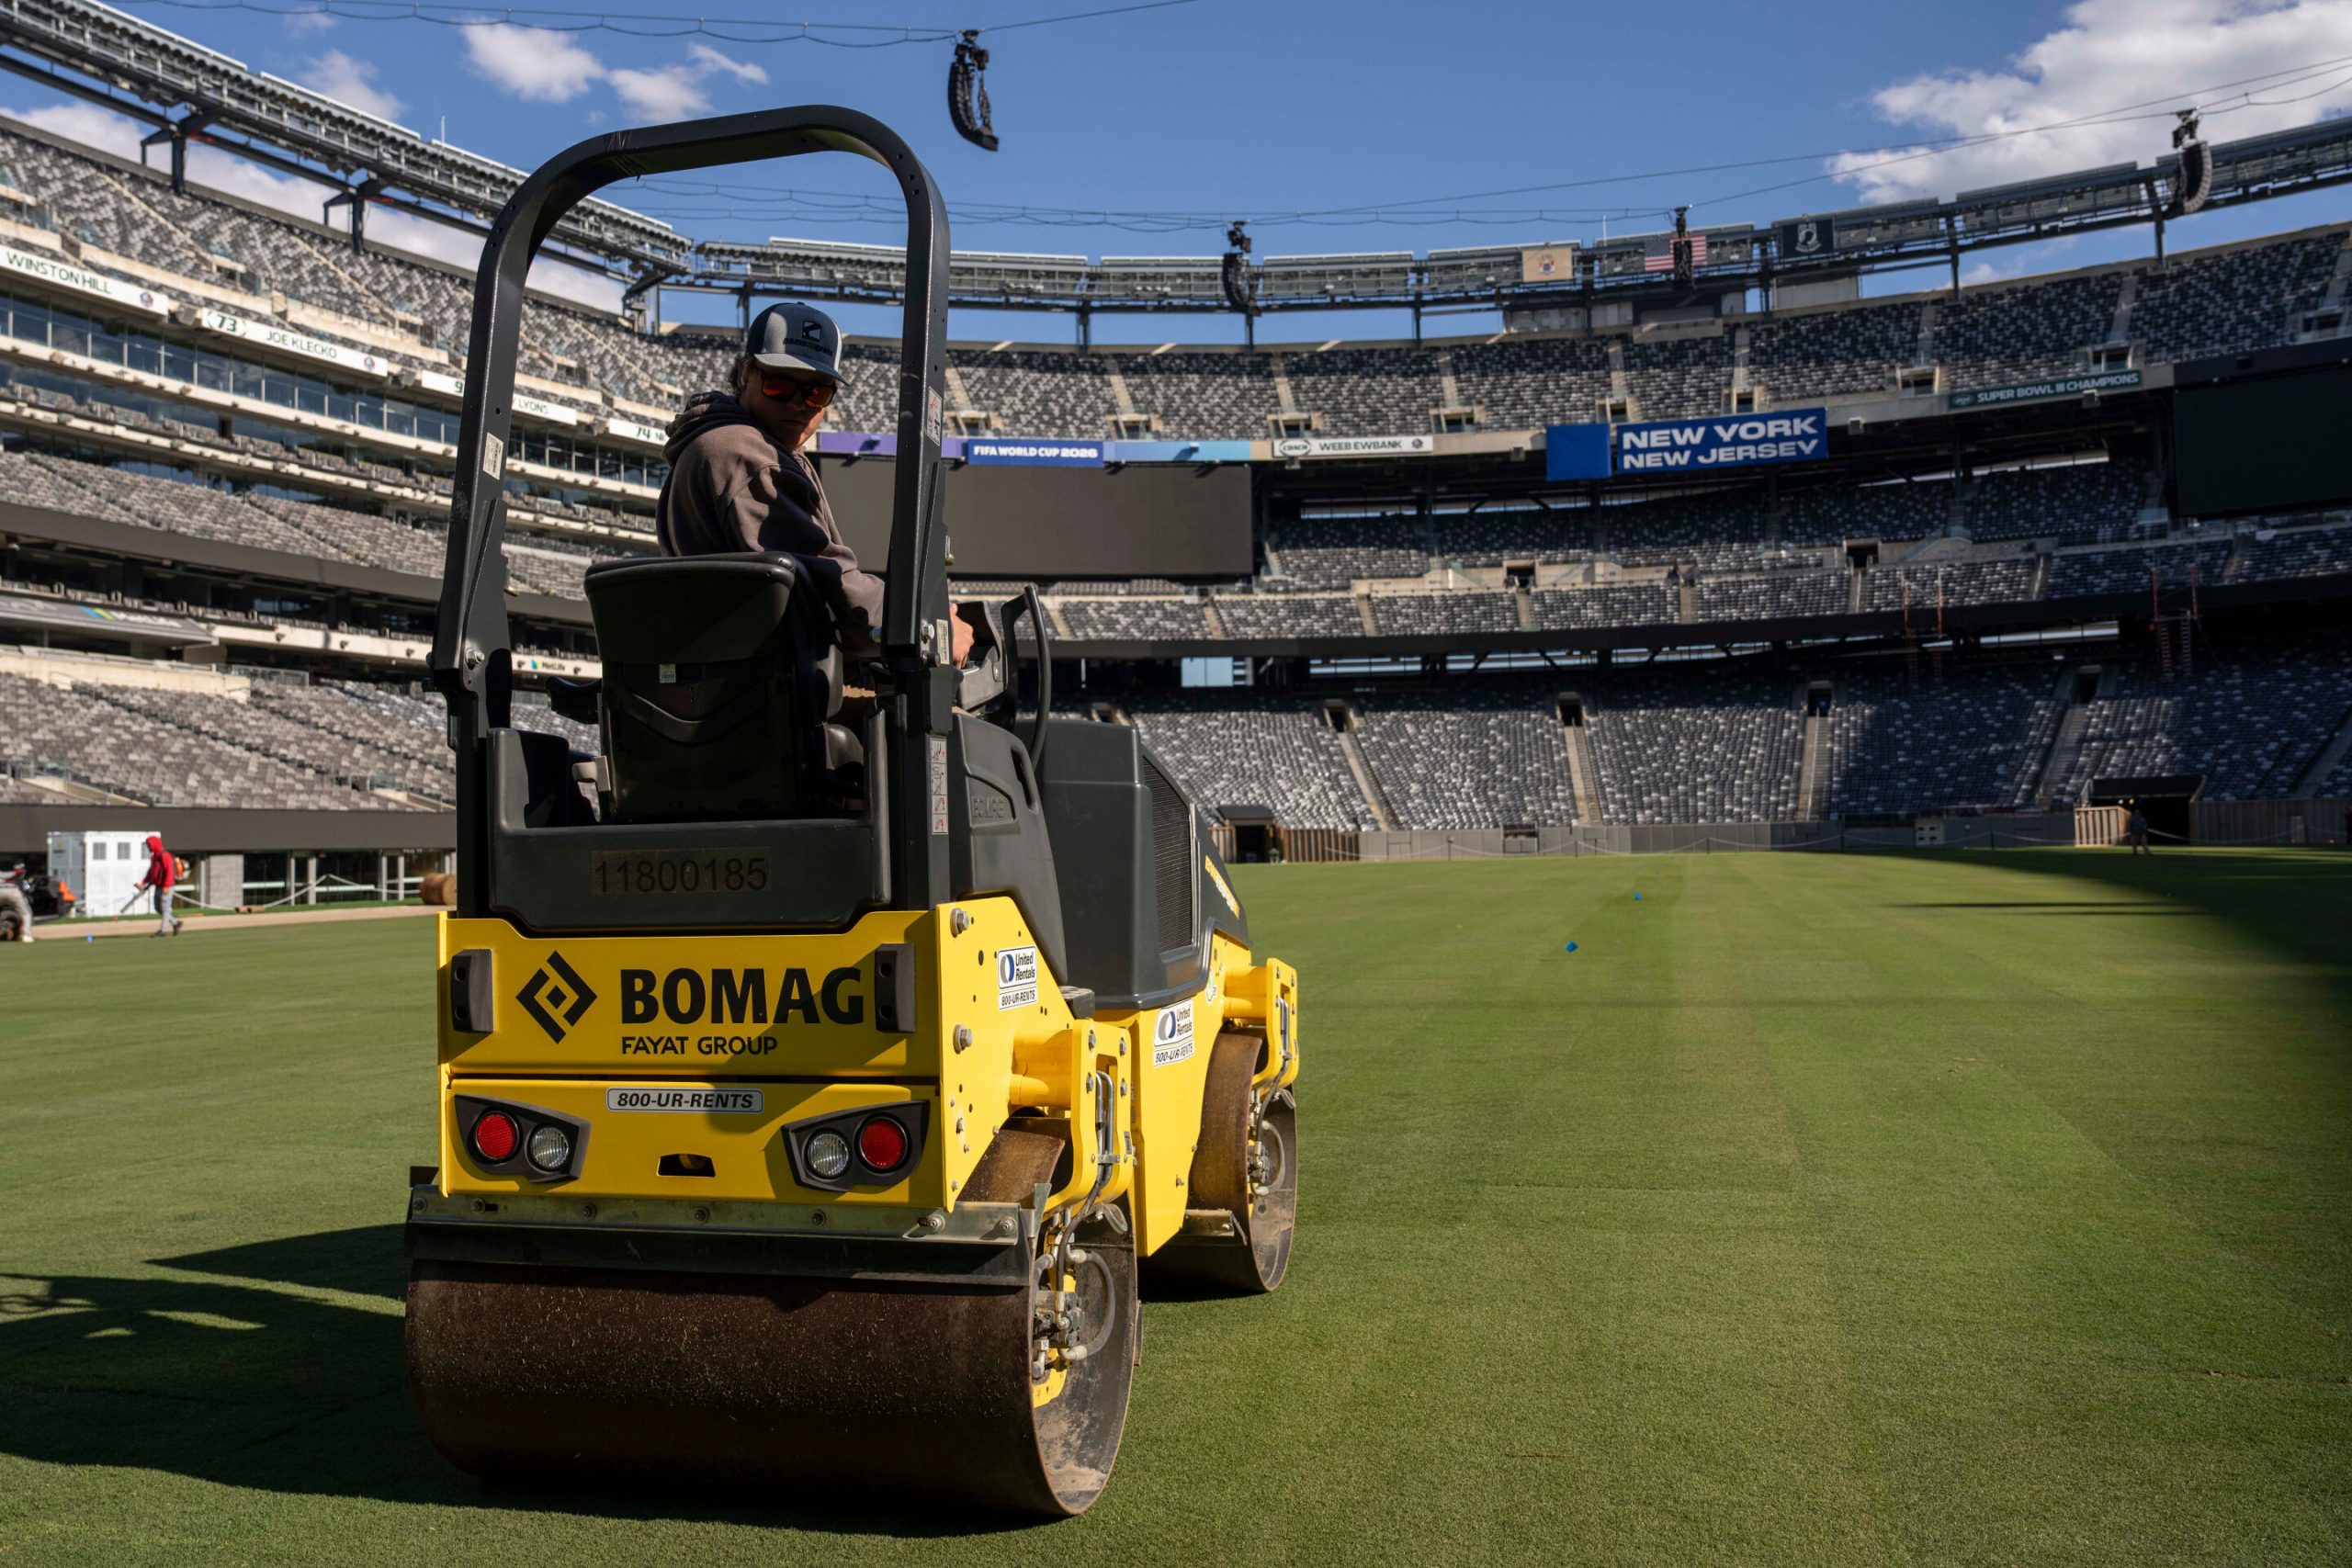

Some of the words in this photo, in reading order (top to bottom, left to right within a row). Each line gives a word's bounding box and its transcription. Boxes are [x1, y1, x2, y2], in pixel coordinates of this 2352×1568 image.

[6, 252, 79, 285] WINSTON
[82, 276, 111, 294] HILL
[216, 314, 236, 333] 73
[266, 331, 288, 346] JOE
[292, 338, 337, 359] KLECKO
[1976, 389, 2014, 403] SUPER
[2016, 385, 2054, 398] BOWL
[2056, 384, 2065, 393] III
[2066, 372, 2139, 391] CHAMPIONS
[518, 398, 549, 415] LYONS
[636, 426, 650, 440] 74
[1623, 425, 1705, 450] NEW
[1713, 416, 1818, 443] YORK
[973, 445, 998, 457] FIFA
[999, 446, 1036, 457] WORLD
[1038, 446, 1059, 457] CUP
[1060, 448, 1099, 458] 2026
[1319, 442, 1351, 451] WEEB
[1354, 439, 1402, 450] EWBANK
[1623, 450, 1690, 470] NEW
[1698, 439, 1818, 465] JERSEY
[542, 660, 565, 671] MetLife
[594, 857, 768, 893] 11800185
[1015, 952, 1034, 966] United
[1015, 967, 1035, 981] Rentals
[620, 967, 865, 1025] BOMAG
[1001, 990, 1035, 1006] 800-UR-RENTS
[1177, 1004, 1192, 1021] United
[1177, 1021, 1193, 1036] Rentals
[621, 1036, 689, 1055] FAYAT
[697, 1036, 778, 1055] GROUP
[1155, 1043, 1193, 1063] 800-UR-RENTS
[617, 1092, 753, 1109] 800-UR-RENTS
